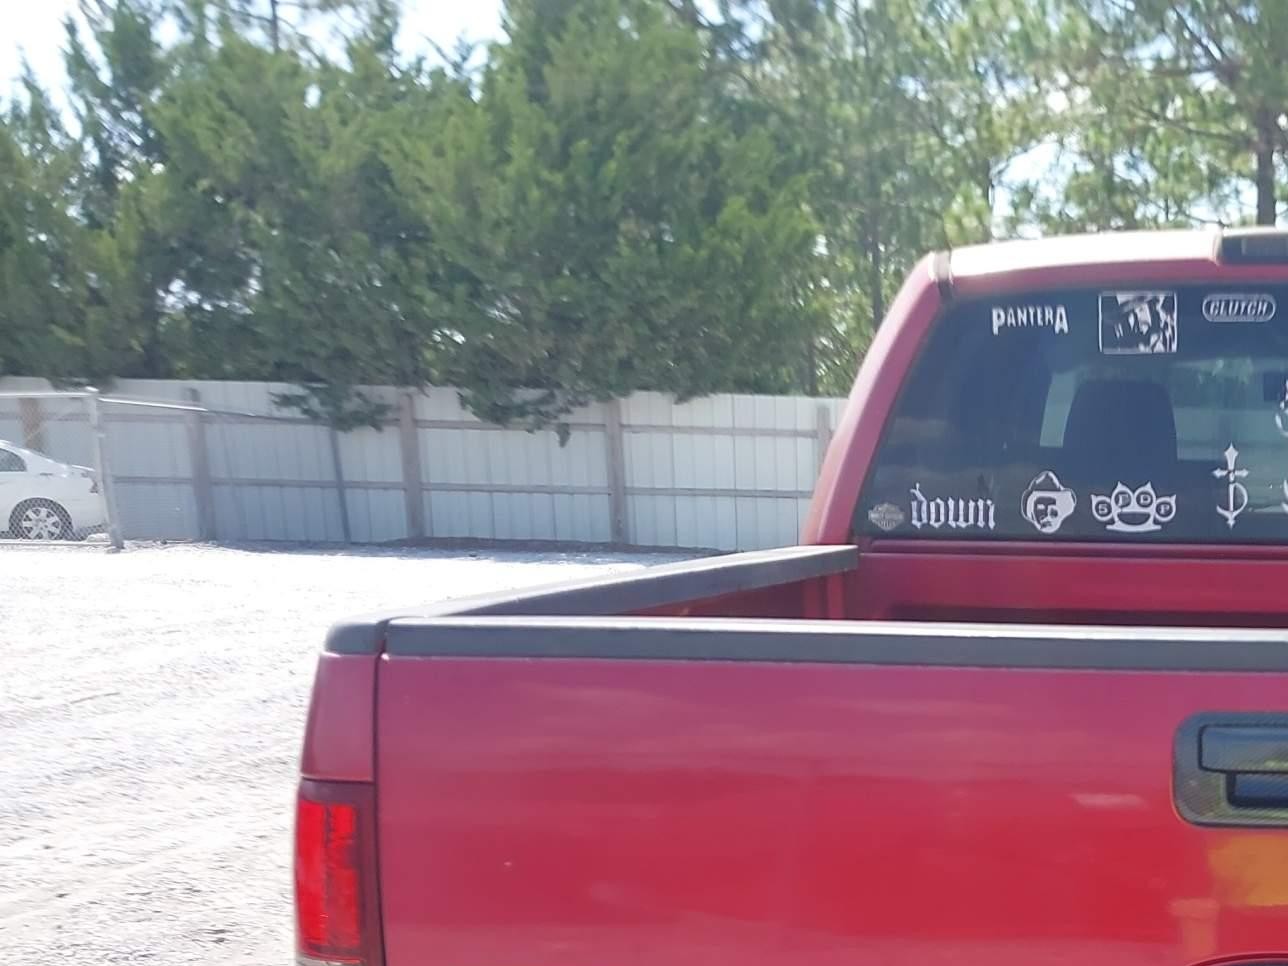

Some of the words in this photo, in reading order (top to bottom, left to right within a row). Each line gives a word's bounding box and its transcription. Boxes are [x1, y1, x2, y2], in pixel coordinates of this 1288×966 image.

[991, 305, 1068, 336] PANTERA
[1208, 299, 1269, 317] CLUTCH
[910, 482, 996, 530] down
